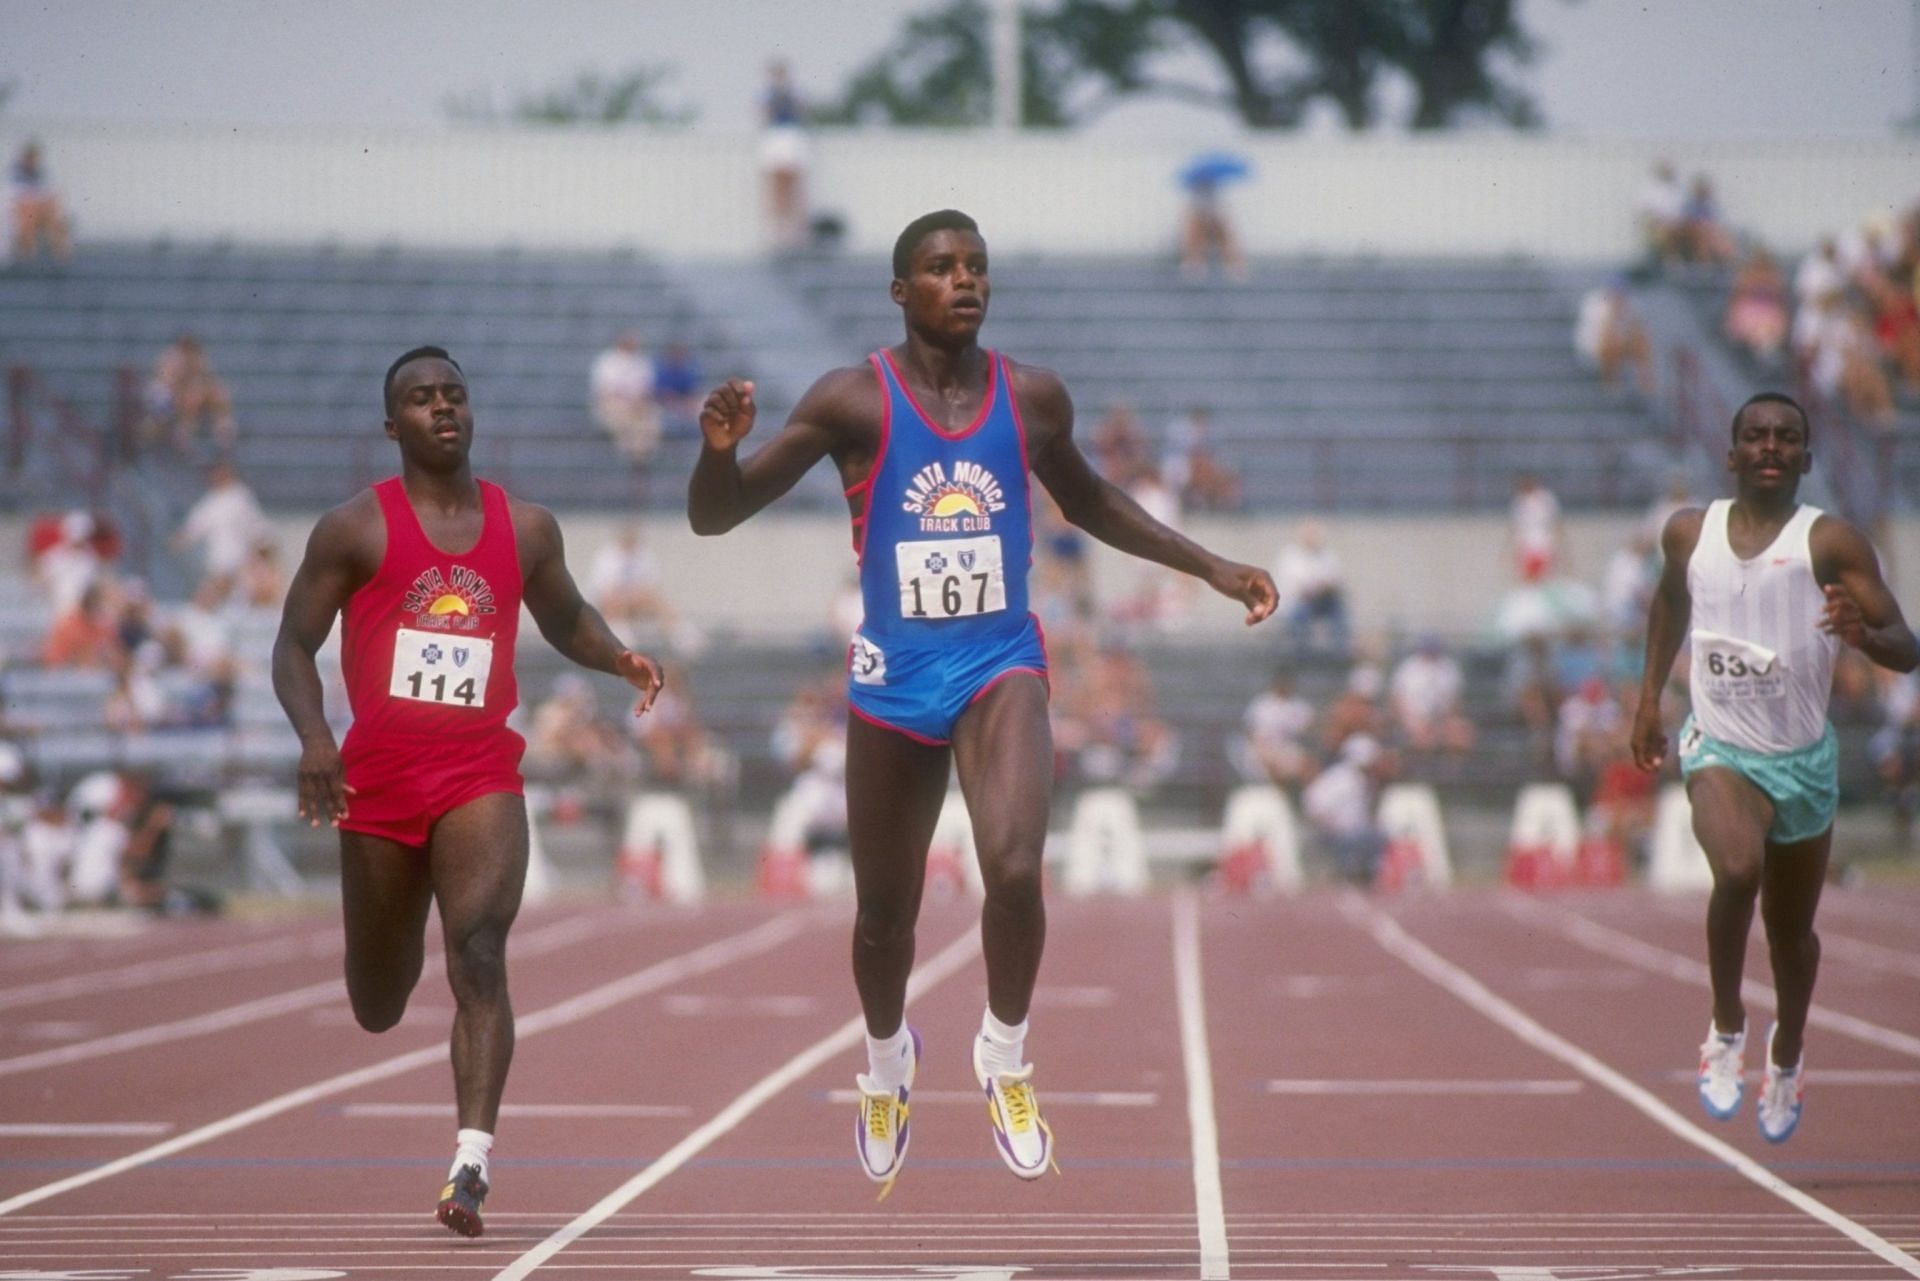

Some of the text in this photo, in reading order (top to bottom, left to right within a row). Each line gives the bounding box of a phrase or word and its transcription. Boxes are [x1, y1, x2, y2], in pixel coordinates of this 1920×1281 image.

[903, 461, 1006, 514] SANTA MONICA
[920, 517, 991, 532] TRACK CLUB
[403, 565, 495, 614] SANTA MONICA
[910, 572, 988, 617] 167
[408, 671, 475, 705] 114
